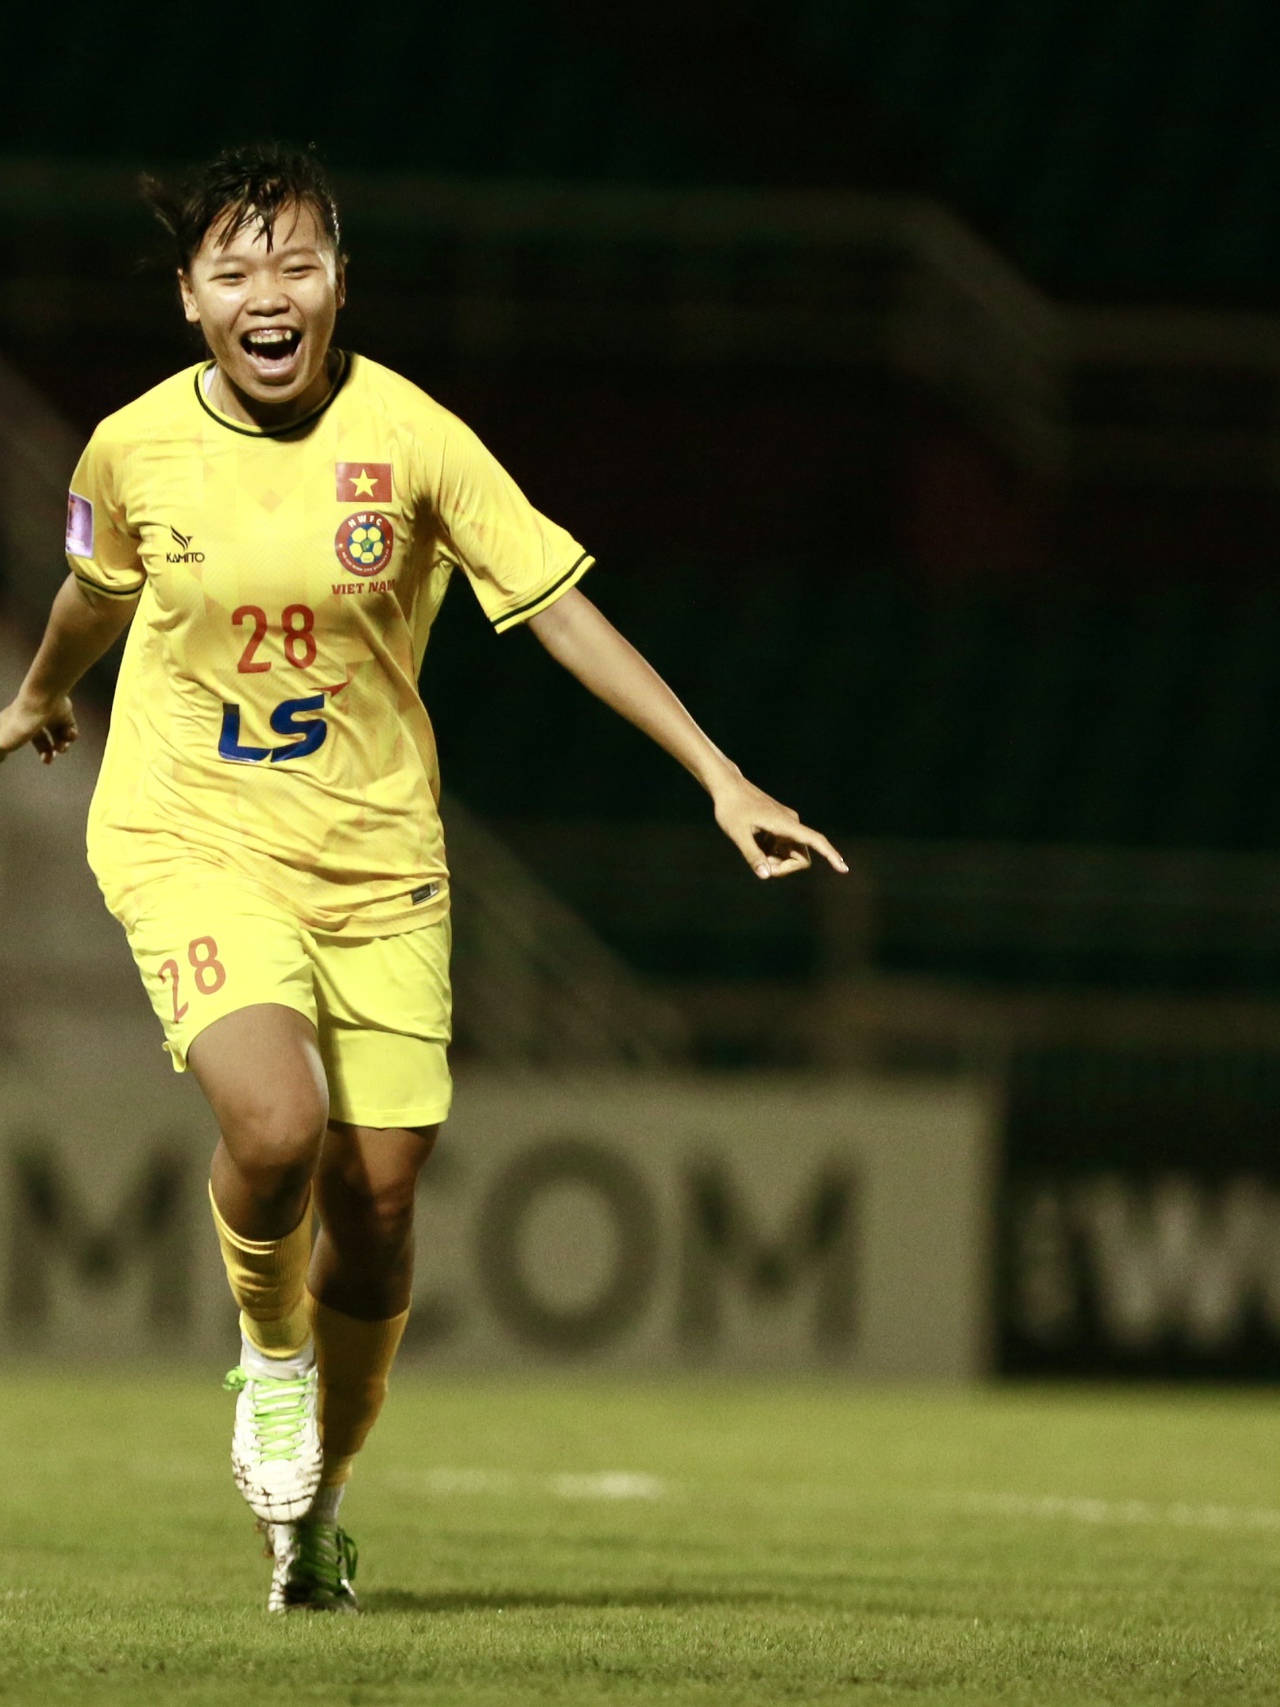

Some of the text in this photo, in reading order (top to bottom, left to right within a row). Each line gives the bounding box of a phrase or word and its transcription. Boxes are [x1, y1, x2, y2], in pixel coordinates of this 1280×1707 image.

[166, 552, 205, 563] KAMITO
[332, 582, 364, 595] VIET
[232, 604, 317, 674] 28
[218, 693, 327, 763] LS
[157, 935, 226, 1024] 28
